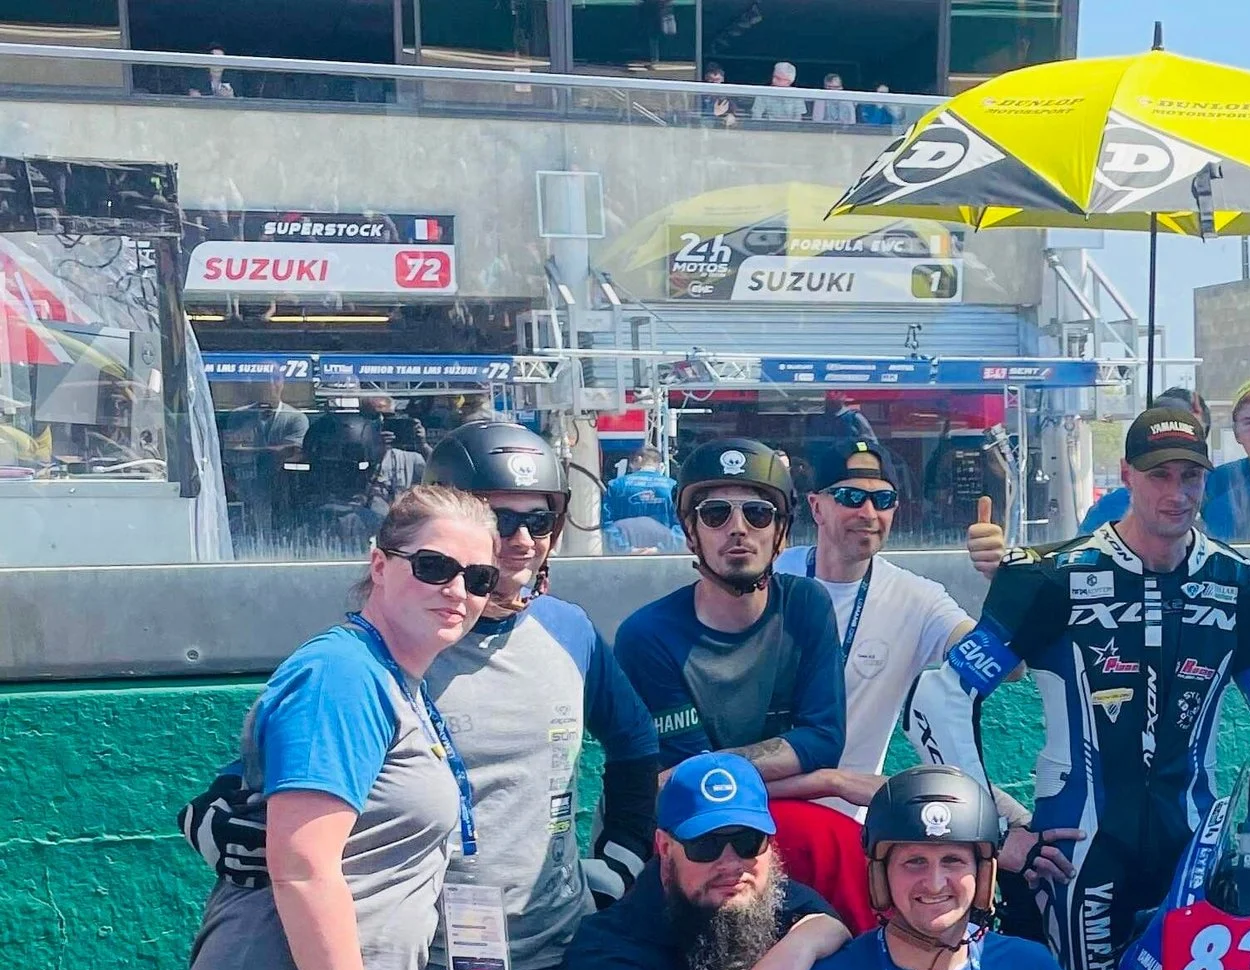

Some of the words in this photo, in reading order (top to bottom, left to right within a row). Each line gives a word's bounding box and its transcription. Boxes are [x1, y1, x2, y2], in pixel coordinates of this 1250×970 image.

[999, 98, 1085, 107] DUNLOP
[264, 222, 384, 237] SUPERSTOCK
[675, 233, 731, 262] 24h
[790, 239, 864, 252] FORMULA
[871, 240, 905, 252] EWC
[203, 257, 329, 281] SUZUKI
[405, 258, 442, 281] 72
[672, 262, 729, 272] MOTOS
[748, 271, 855, 292] SUZUKI
[931, 271, 942, 292] 1
[217, 364, 235, 373] LMS
[238, 363, 274, 373] SUZUKI
[359, 365, 394, 375] JUNIOR
[396, 365, 421, 375] TEAM
[423, 365, 442, 375] LMS
[443, 365, 477, 375] SUZUKI
[959, 640, 1002, 679] EWC
[654, 707, 699, 733] HANIC
